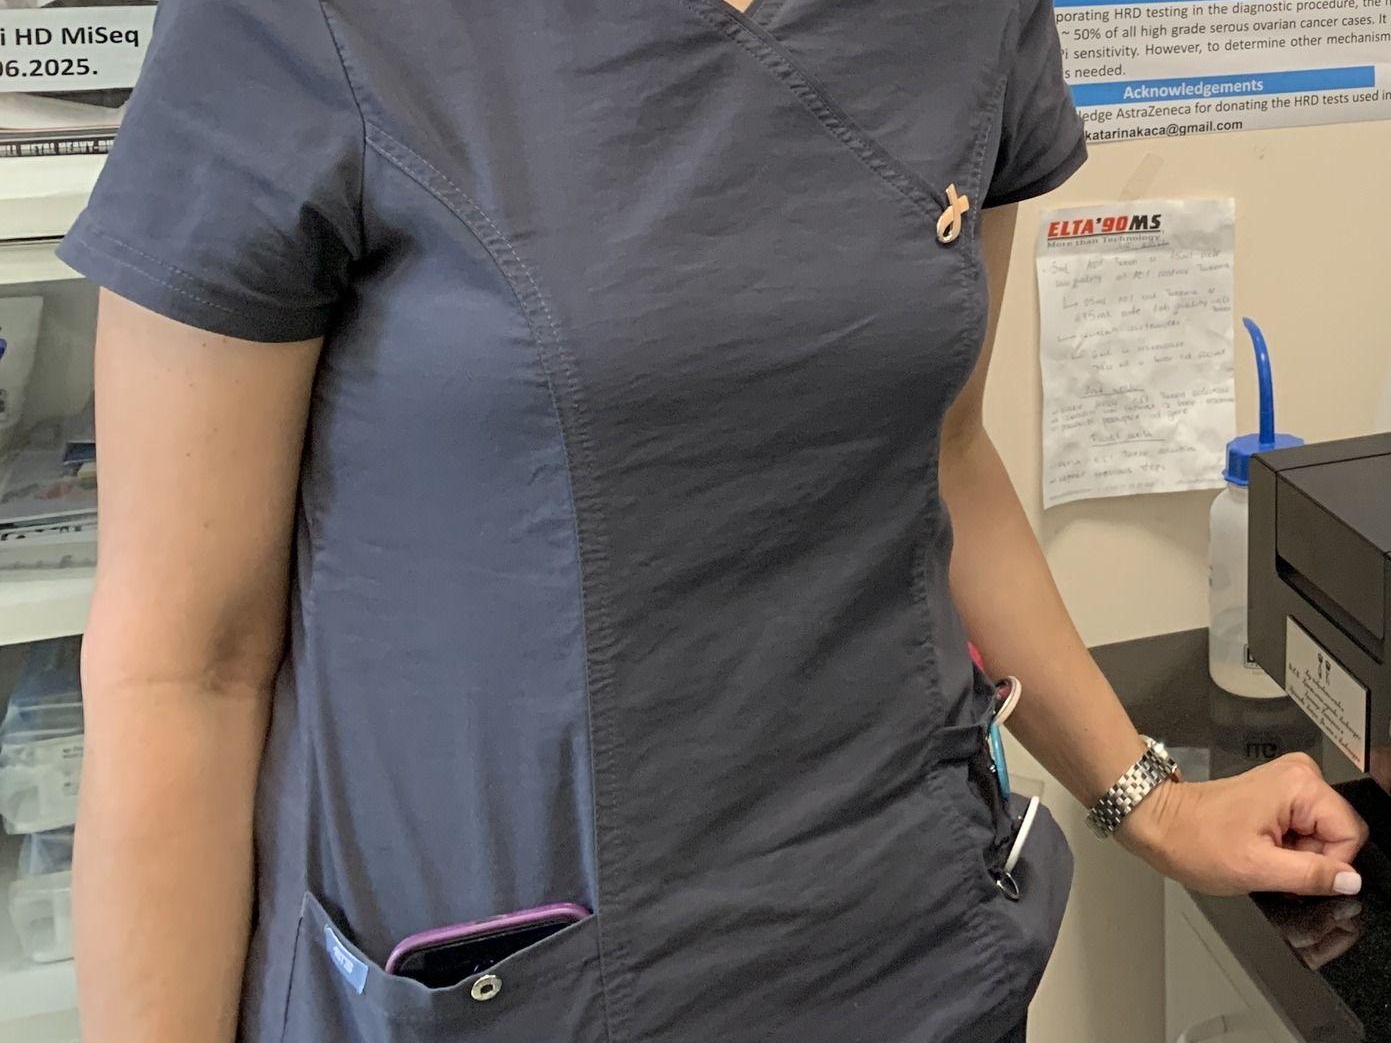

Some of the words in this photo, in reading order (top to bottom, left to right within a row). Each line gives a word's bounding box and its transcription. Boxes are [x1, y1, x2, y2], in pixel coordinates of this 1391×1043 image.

[15, 28, 53, 46] HD
[61, 26, 139, 47] MiSeq
[0, 58, 98, 77] 6.2025.
[1123, 79, 1263, 99] Acknowledgements
[1323, 94, 1349, 104] tests
[1352, 89, 1378, 102] used
[1382, 90, 1391, 100] in
[1048, 240, 1073, 249] More
[1075, 238, 1098, 247] than
[1102, 234, 1160, 244] Technology
